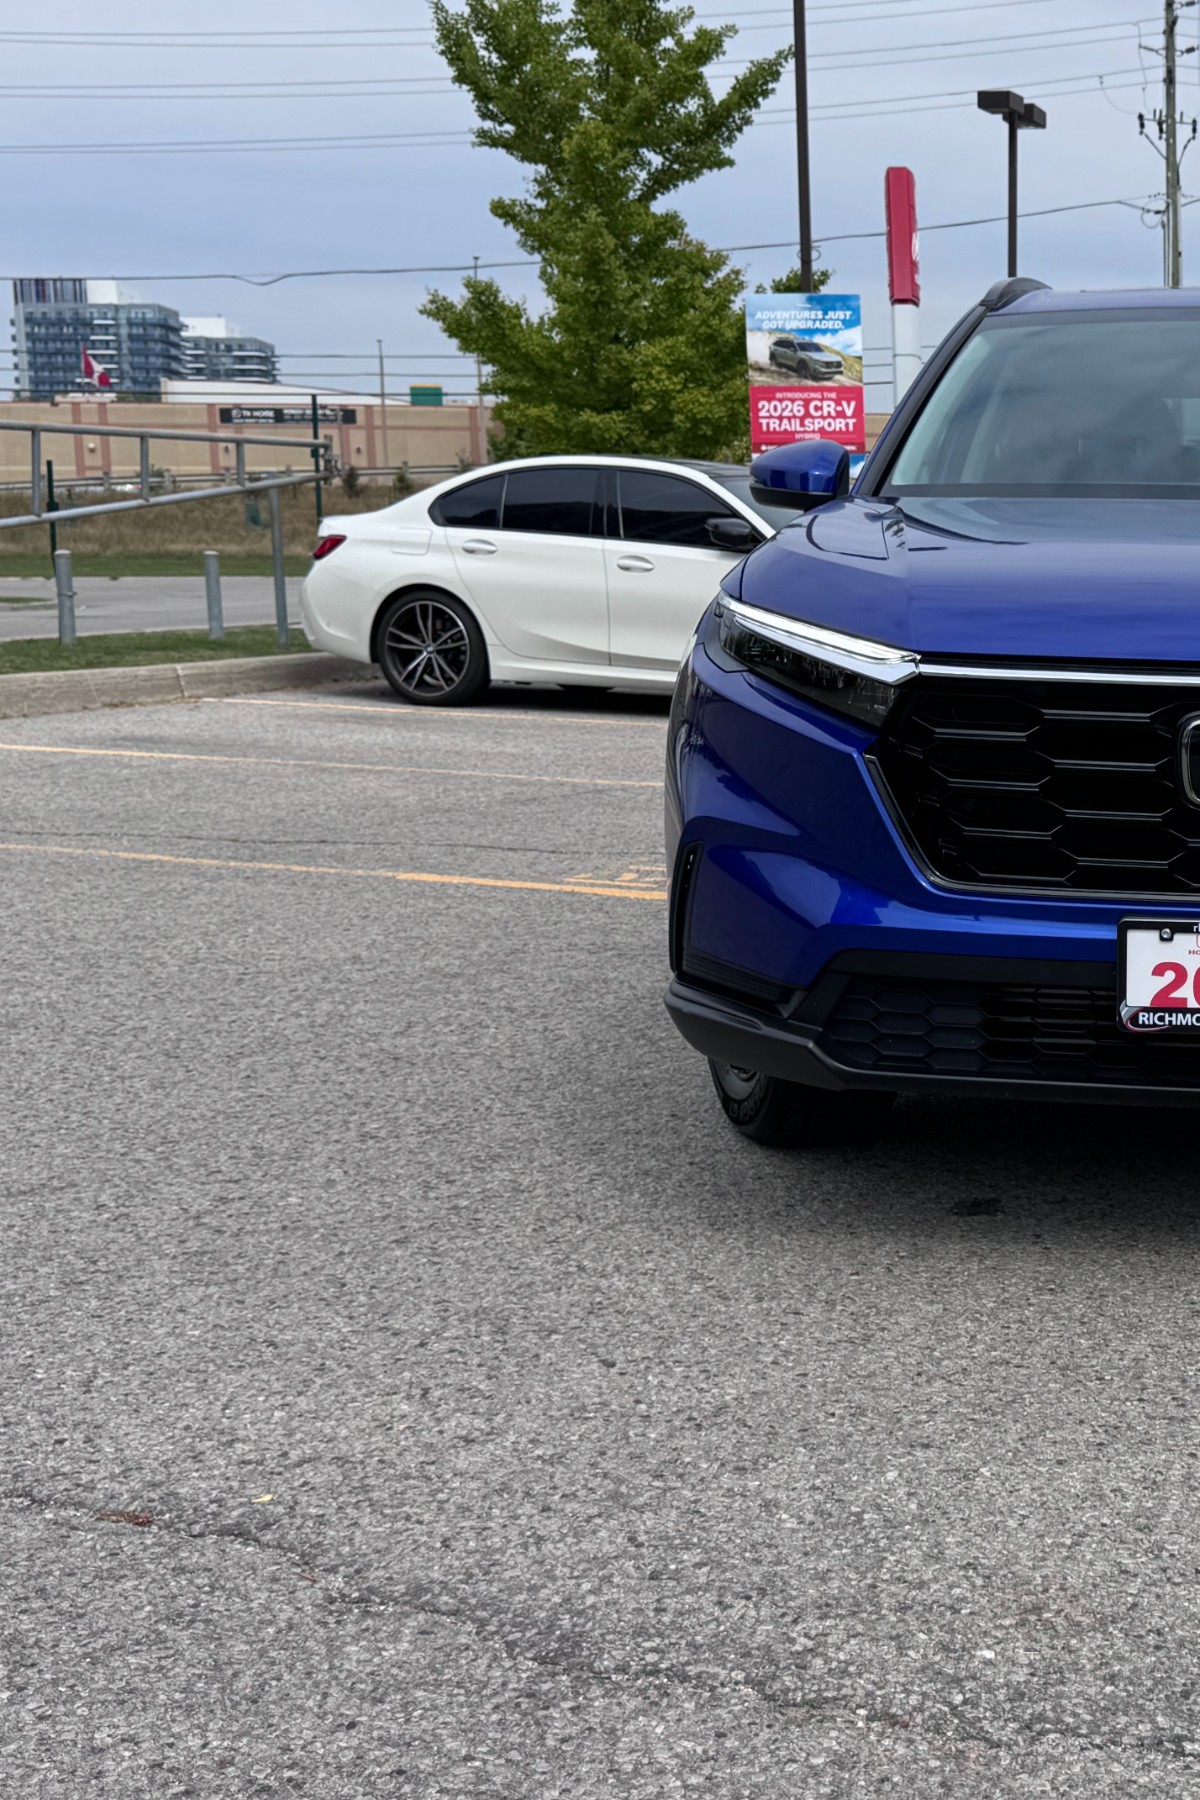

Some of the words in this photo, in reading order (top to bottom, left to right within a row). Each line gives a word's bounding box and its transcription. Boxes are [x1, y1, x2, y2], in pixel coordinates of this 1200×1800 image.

[755, 311, 823, 320] ADVENTURES
[824, 311, 852, 320] JUST
[762, 320, 784, 329] GOT
[785, 320, 845, 330] UPGRADED.
[758, 400, 805, 417] 2026
[809, 400, 856, 417] CR-V
[759, 418, 857, 432] TRAILSPORT
